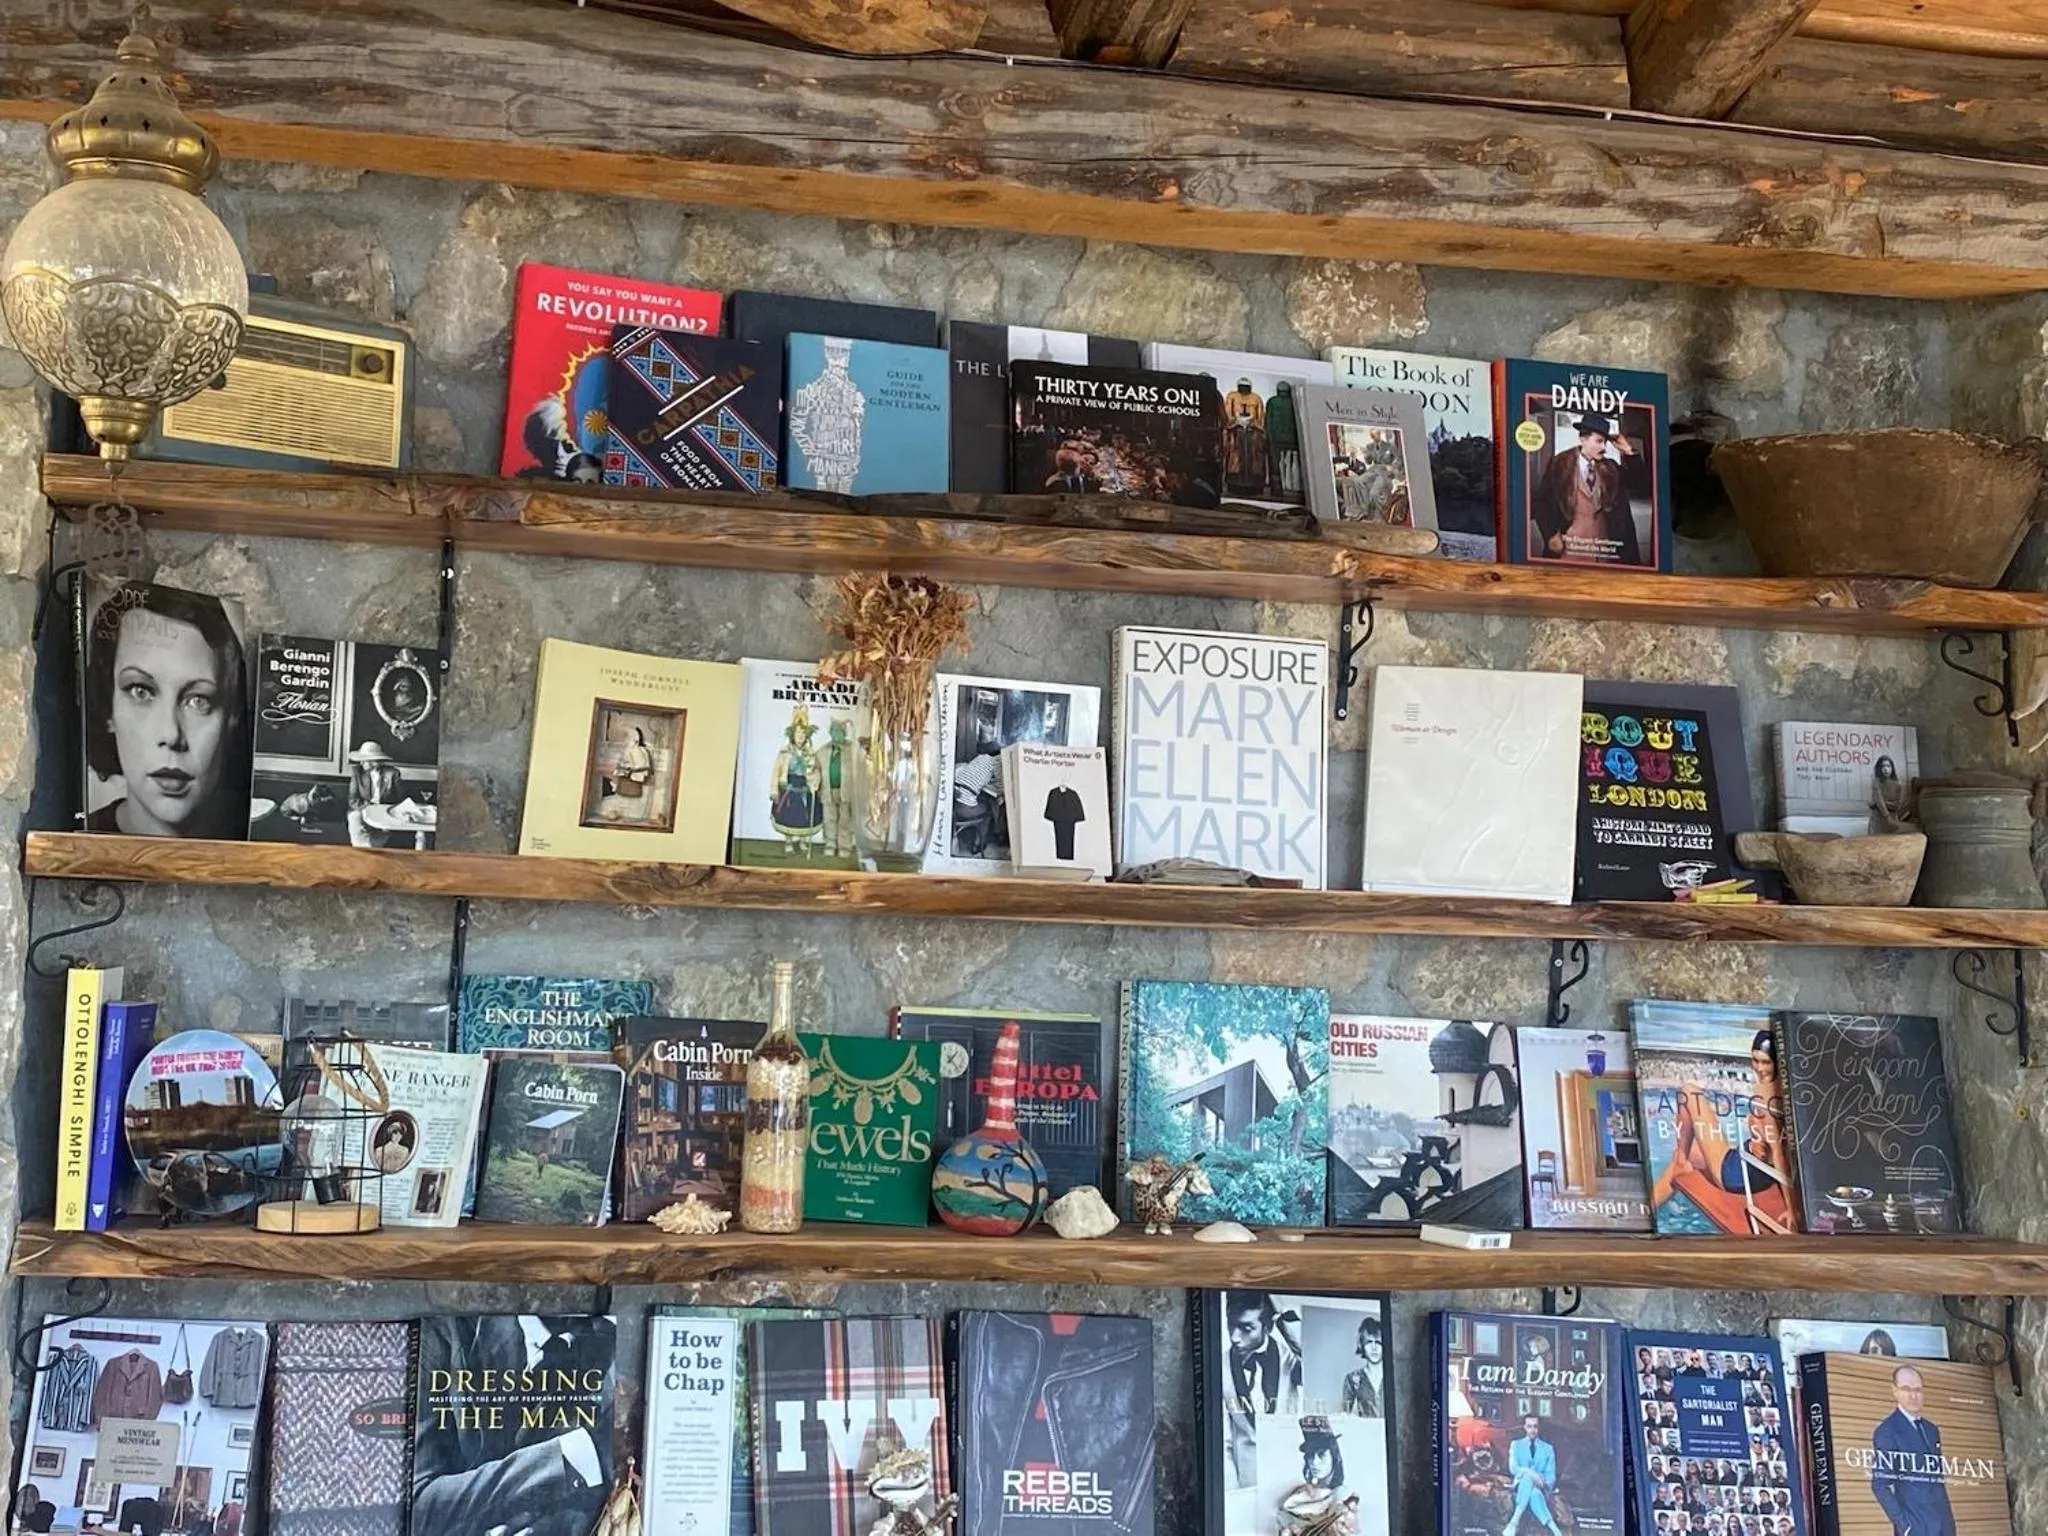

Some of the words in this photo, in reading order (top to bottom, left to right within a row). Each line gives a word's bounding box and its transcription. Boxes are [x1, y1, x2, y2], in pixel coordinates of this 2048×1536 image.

[568, 282, 590, 293] YOU
[593, 286, 612, 298] SAY
[616, 289, 637, 301] YOU
[641, 293, 672, 307] WANT
[675, 299, 683, 308] A
[886, 370, 925, 382] GUIDE
[956, 359, 990, 377] THE
[1341, 355, 1386, 378] The
[1393, 359, 1447, 384] Book
[1452, 368, 1474, 388] of
[1035, 376, 1099, 397] THIRTY
[1104, 382, 1158, 402] YEARS
[1164, 388, 1200, 406] ON!
[1569, 372, 1586, 387] WE
[1587, 374, 1609, 388] ARE
[869, 397, 942, 413] GENTLEMAN
[880, 387, 932, 401] MODERN
[1551, 384, 1628, 415] DANDY
[1046, 395, 1081, 406] PRIVATE
[1084, 398, 1106, 408] VIEW
[1109, 400, 1121, 410] OF
[1124, 402, 1154, 413] PUBLIC
[1157, 404, 1200, 417] SCHOOLS
[660, 452, 674, 465] OF
[669, 446, 685, 460] THE
[685, 461, 713, 489] HEART
[677, 440, 700, 464] FOOD
[699, 463, 724, 488] FROM
[283, 649, 330, 663] Gianni
[1133, 640, 1318, 685] EXPOSURE
[270, 660, 330, 678] Berengo
[281, 674, 329, 688] Gardin
[1131, 677, 1316, 745] MARY
[1581, 712, 1699, 751] BOUT
[1794, 731, 1894, 749] LEGENDARY
[1023, 747, 1043, 757] What
[1045, 750, 1071, 758] Artists
[1796, 749, 1871, 765] AUTHORS
[1130, 738, 1317, 810] ELLEN
[1584, 746, 1702, 783] IQUE
[1589, 784, 1708, 811] LONDON
[1128, 802, 1316, 874] MARK
[1593, 831, 1611, 843] TO
[1668, 836, 1713, 850] STREET
[541, 990, 582, 1007] THE
[528, 1028, 590, 1047] ROOM
[1330, 1022, 1359, 1039] OLD
[1362, 1023, 1429, 1042] RUSSIAN
[72, 993, 91, 1106] OTTOLENGHI
[653, 1039, 707, 1063] Cabin
[1331, 1041, 1378, 1058] CITIES
[1775, 1020, 1789, 1090] HEIRLOOM
[408, 1071, 471, 1088] RANGER
[686, 1065, 724, 1081] Inside
[525, 1082, 564, 1099] Cabin
[567, 1086, 599, 1104] Porn
[974, 1077, 1100, 1101] EROPA
[1658, 1091, 1705, 1116] ART
[1715, 1092, 1784, 1118] DECO
[1658, 1120, 1683, 1139] BY
[1695, 1122, 1737, 1142] THE
[1751, 1124, 1787, 1144] SEA
[67, 1116, 84, 1177] SIMPLE
[670, 1330, 723, 1348] How
[669, 1351, 691, 1369] to
[696, 1352, 722, 1370] be
[429, 1369, 604, 1393] DRESSING
[664, 1372, 725, 1396] Chap
[1460, 1356, 1474, 1381] I
[1477, 1365, 1516, 1383] am
[1521, 1360, 1606, 1395] Dandy
[1700, 1385, 1717, 1396] THE
[1682, 1398, 1738, 1411] SARTORIALIST
[355, 1412, 375, 1425] SO
[432, 1406, 504, 1430] THE
[521, 1406, 597, 1430] MAN
[1701, 1414, 1724, 1427] MAN
[117, 1436, 161, 1446] MENSWEAR
[124, 1428, 157, 1438] VINTAGE
[775, 1398, 940, 1472] IVY
[1810, 1403, 1832, 1507] GENTLEMAN
[1845, 1447, 1995, 1479] GENTLEMAN
[1003, 1470, 1113, 1496] REBEL
[1003, 1495, 1113, 1514] THREADS
